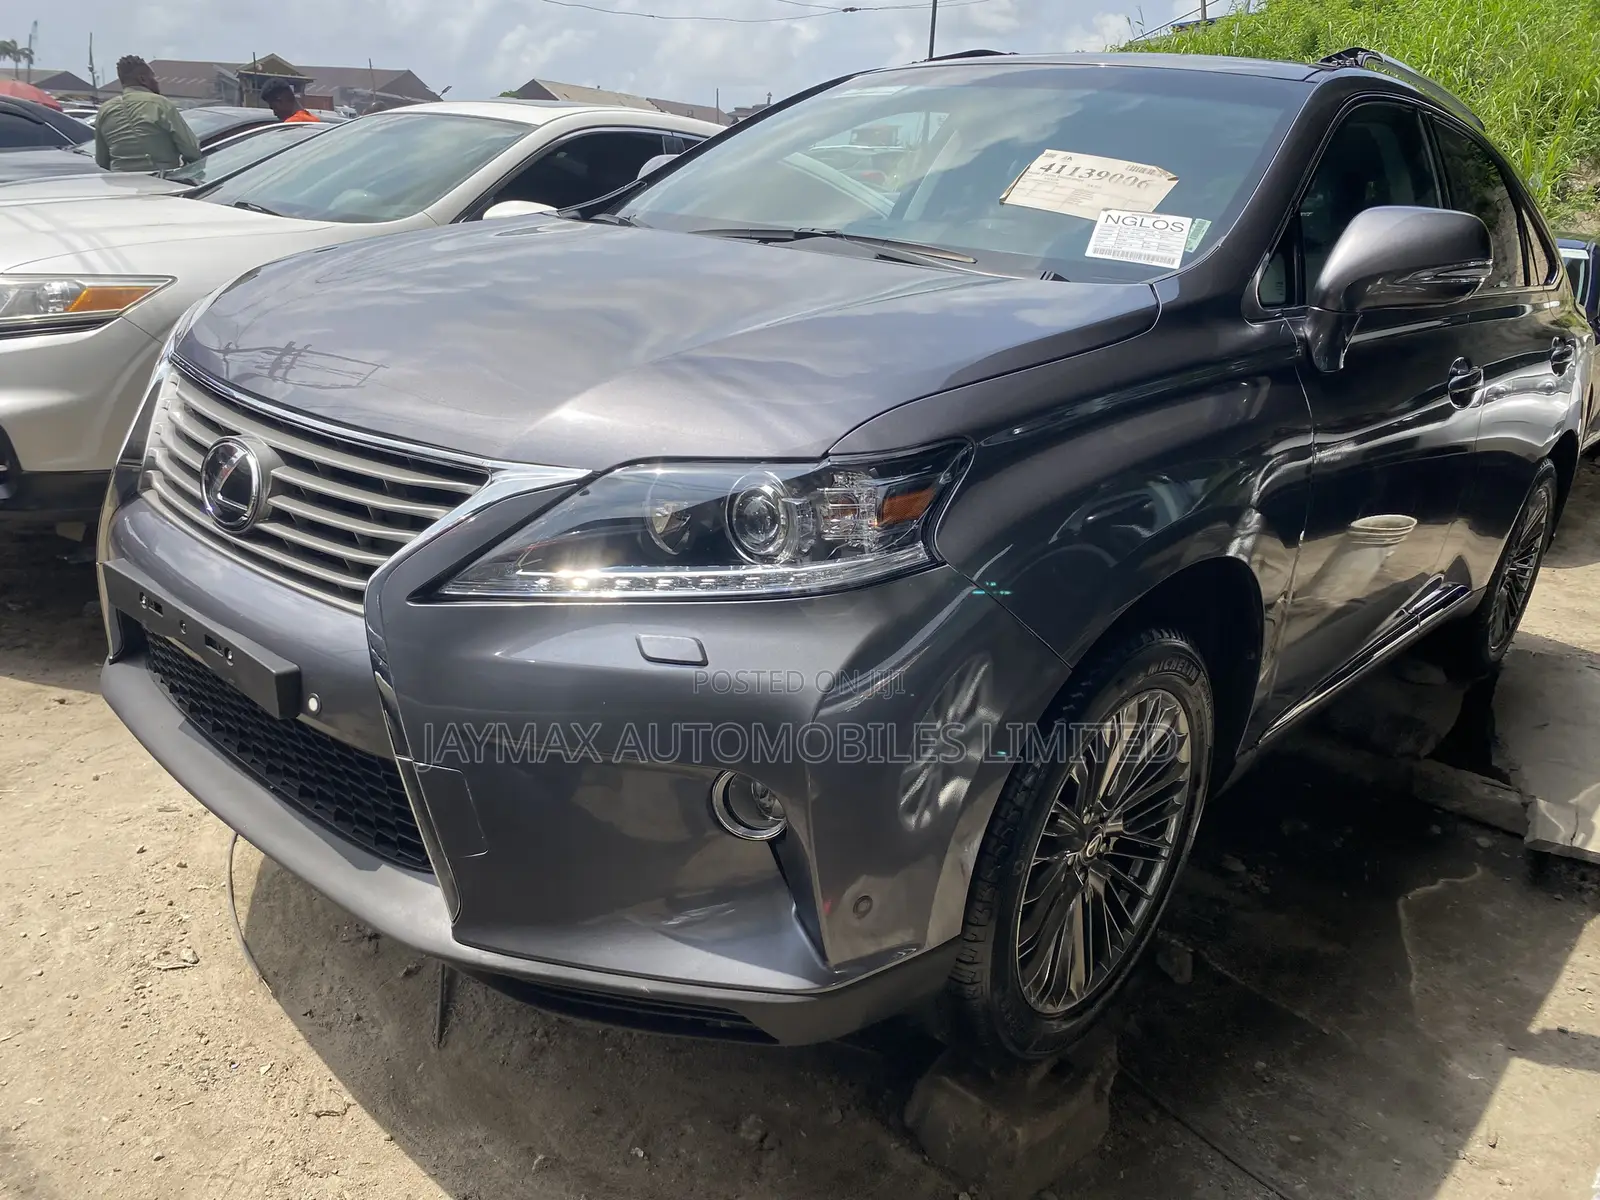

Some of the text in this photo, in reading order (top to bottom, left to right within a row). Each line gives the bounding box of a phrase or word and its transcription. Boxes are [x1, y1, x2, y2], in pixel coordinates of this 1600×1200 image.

[1039, 162, 1155, 190] 41139006
[1104, 214, 1185, 233] NGLOS
[1147, 659, 1200, 681] MICHELIN
